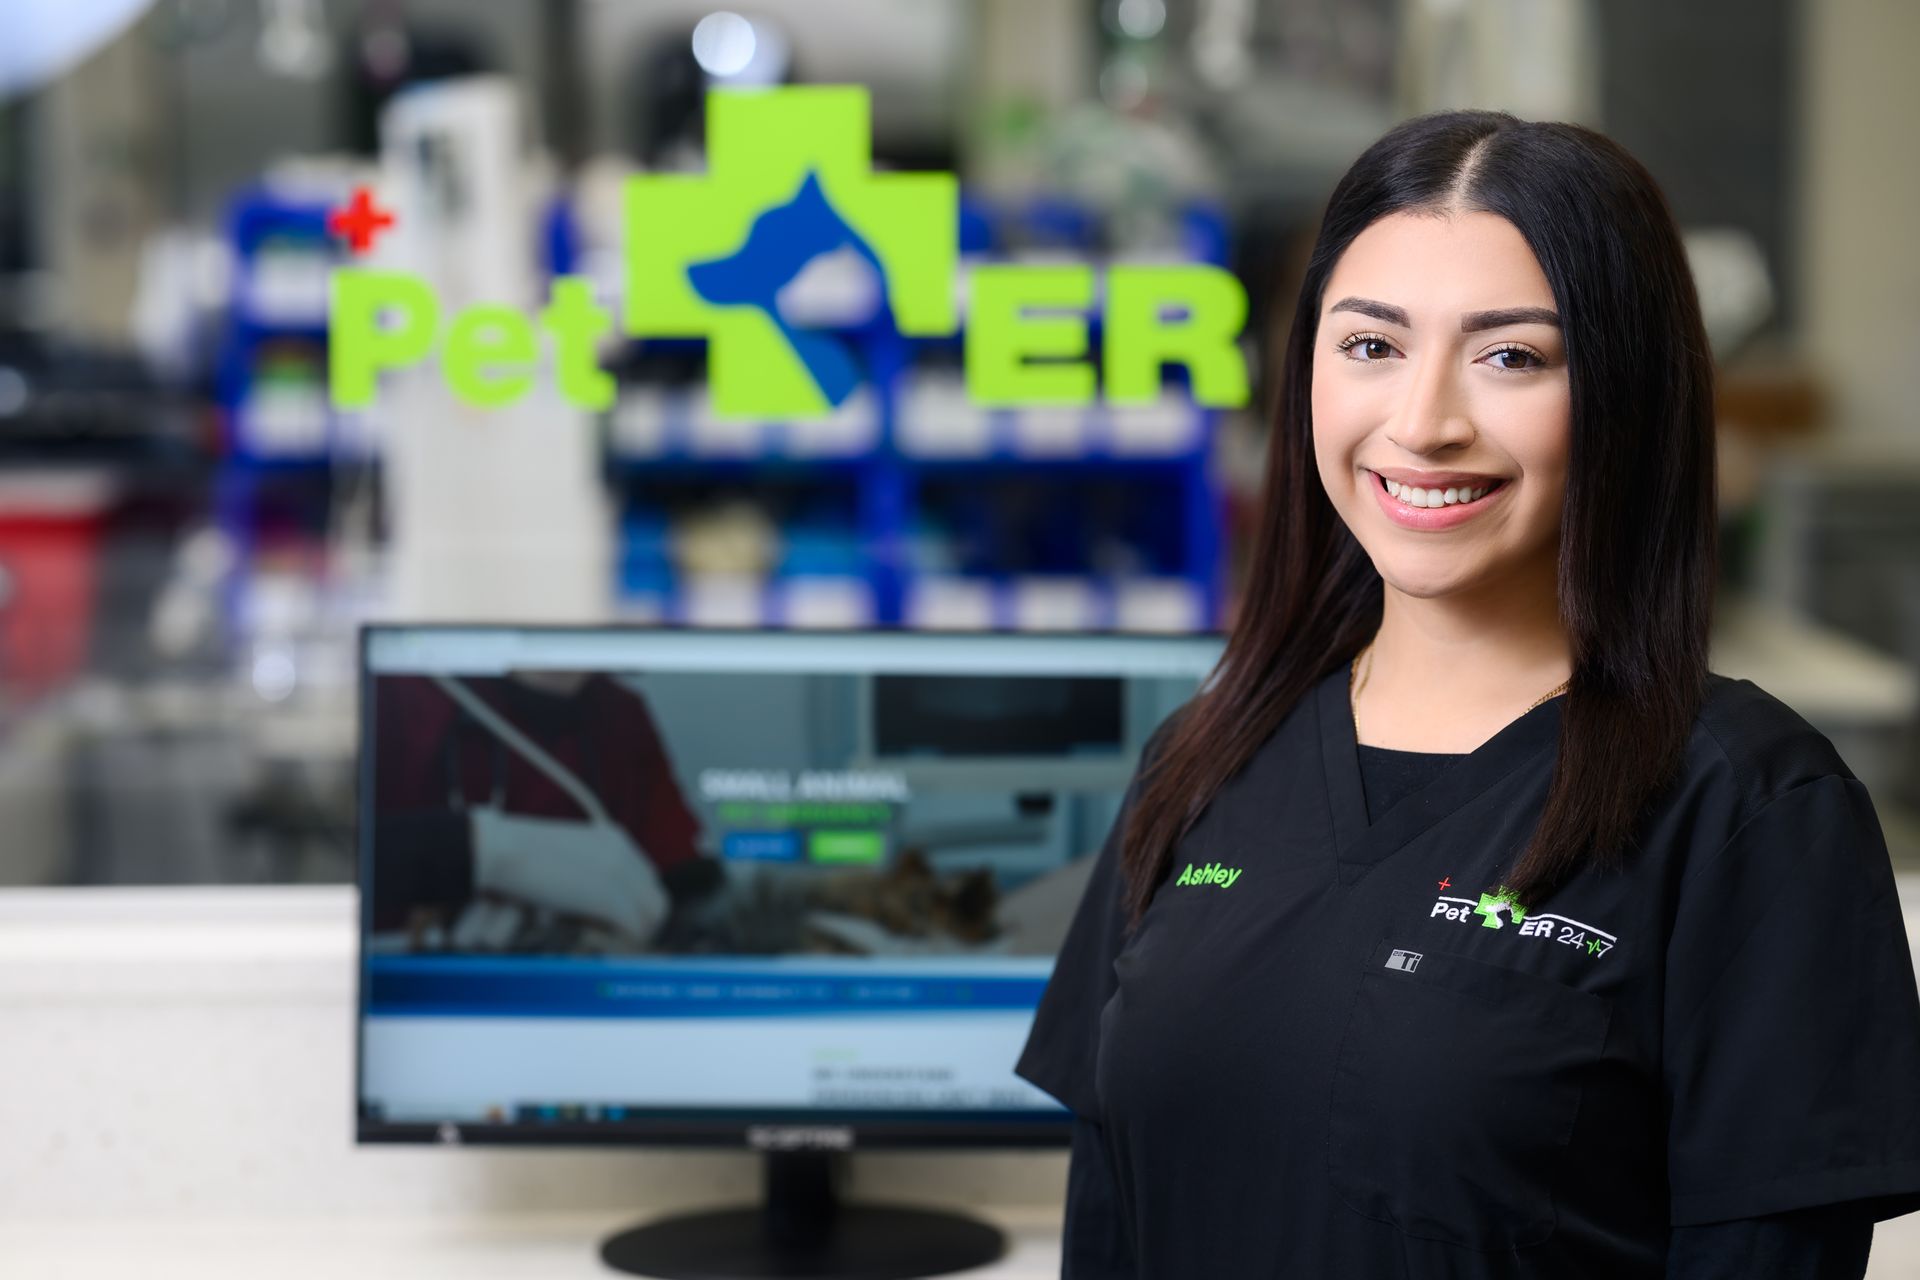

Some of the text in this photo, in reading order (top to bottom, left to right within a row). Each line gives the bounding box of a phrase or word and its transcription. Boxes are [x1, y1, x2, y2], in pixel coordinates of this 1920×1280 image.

[329, 265, 1250, 410] Pet ER
[1176, 862, 1242, 888] Ashley
[1430, 902, 1470, 923] Pet
[1518, 919, 1554, 938] ER
